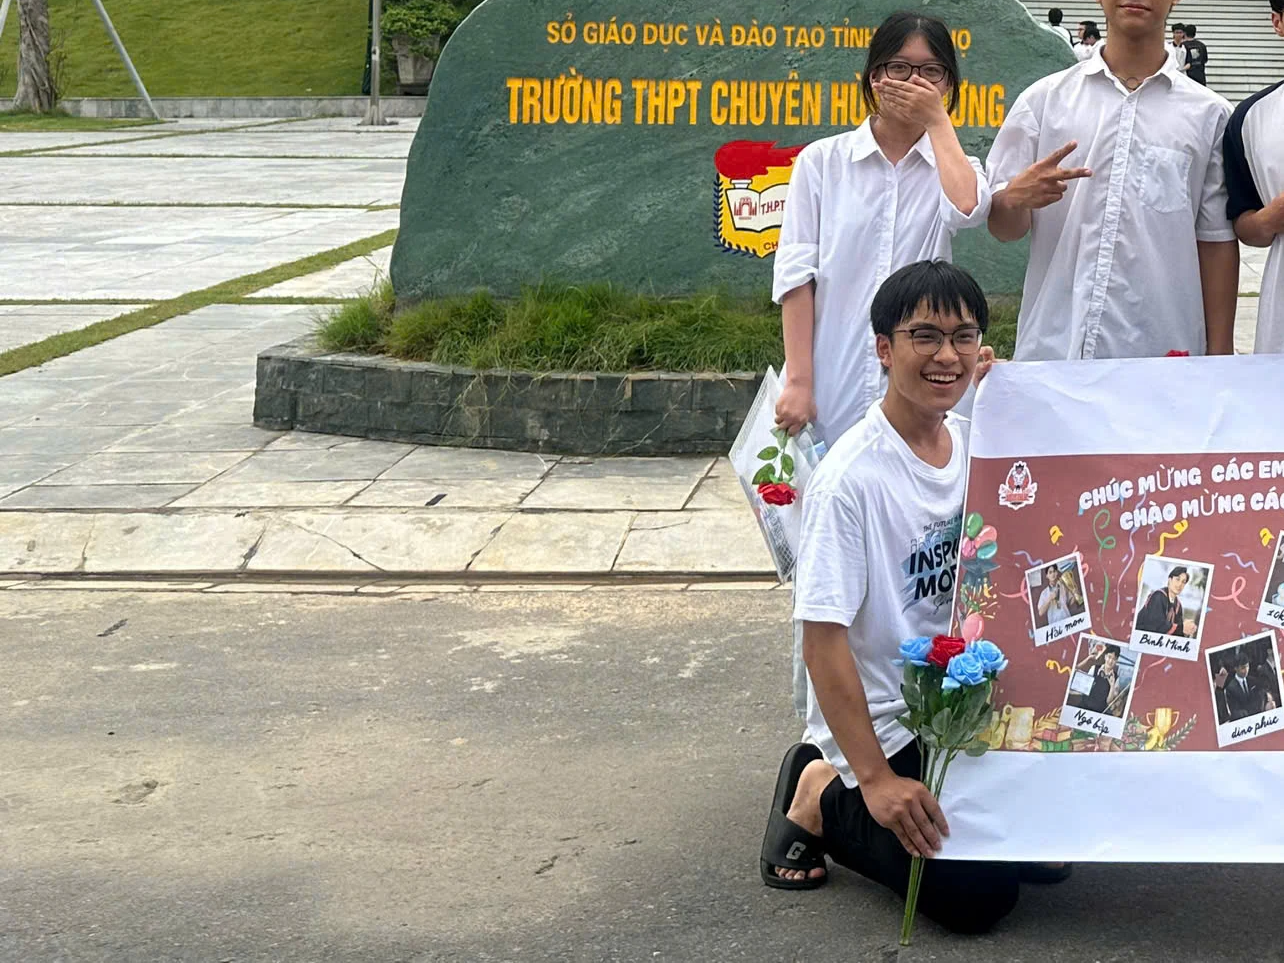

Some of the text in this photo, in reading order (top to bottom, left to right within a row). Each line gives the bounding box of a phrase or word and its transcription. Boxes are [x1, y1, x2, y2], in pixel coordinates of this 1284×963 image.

[547, 12, 577, 44] SỞ
[583, 16, 636, 45] GIÁO
[643, 23, 688, 53] DỤC
[696, 17, 725, 46] VÀ
[731, 18, 776, 47] ĐÀO
[783, 25, 825, 54] TẠO
[506, 66, 622, 125] TRƯỜNG
[631, 78, 702, 125] THPT
[711, 70, 822, 126] CHUYÊN
[831, 72, 868, 127] HÙ
[1079, 477, 1133, 510] CHÚC
[1138, 464, 1202, 495] MỪNG
[1211, 457, 1254, 482] CÁC
[1120, 501, 1177, 530] CHÀO
[1182, 489, 1246, 519] MỪNG
[910, 538, 960, 574] INSPI
[1164, 638, 1191, 653] Minh
